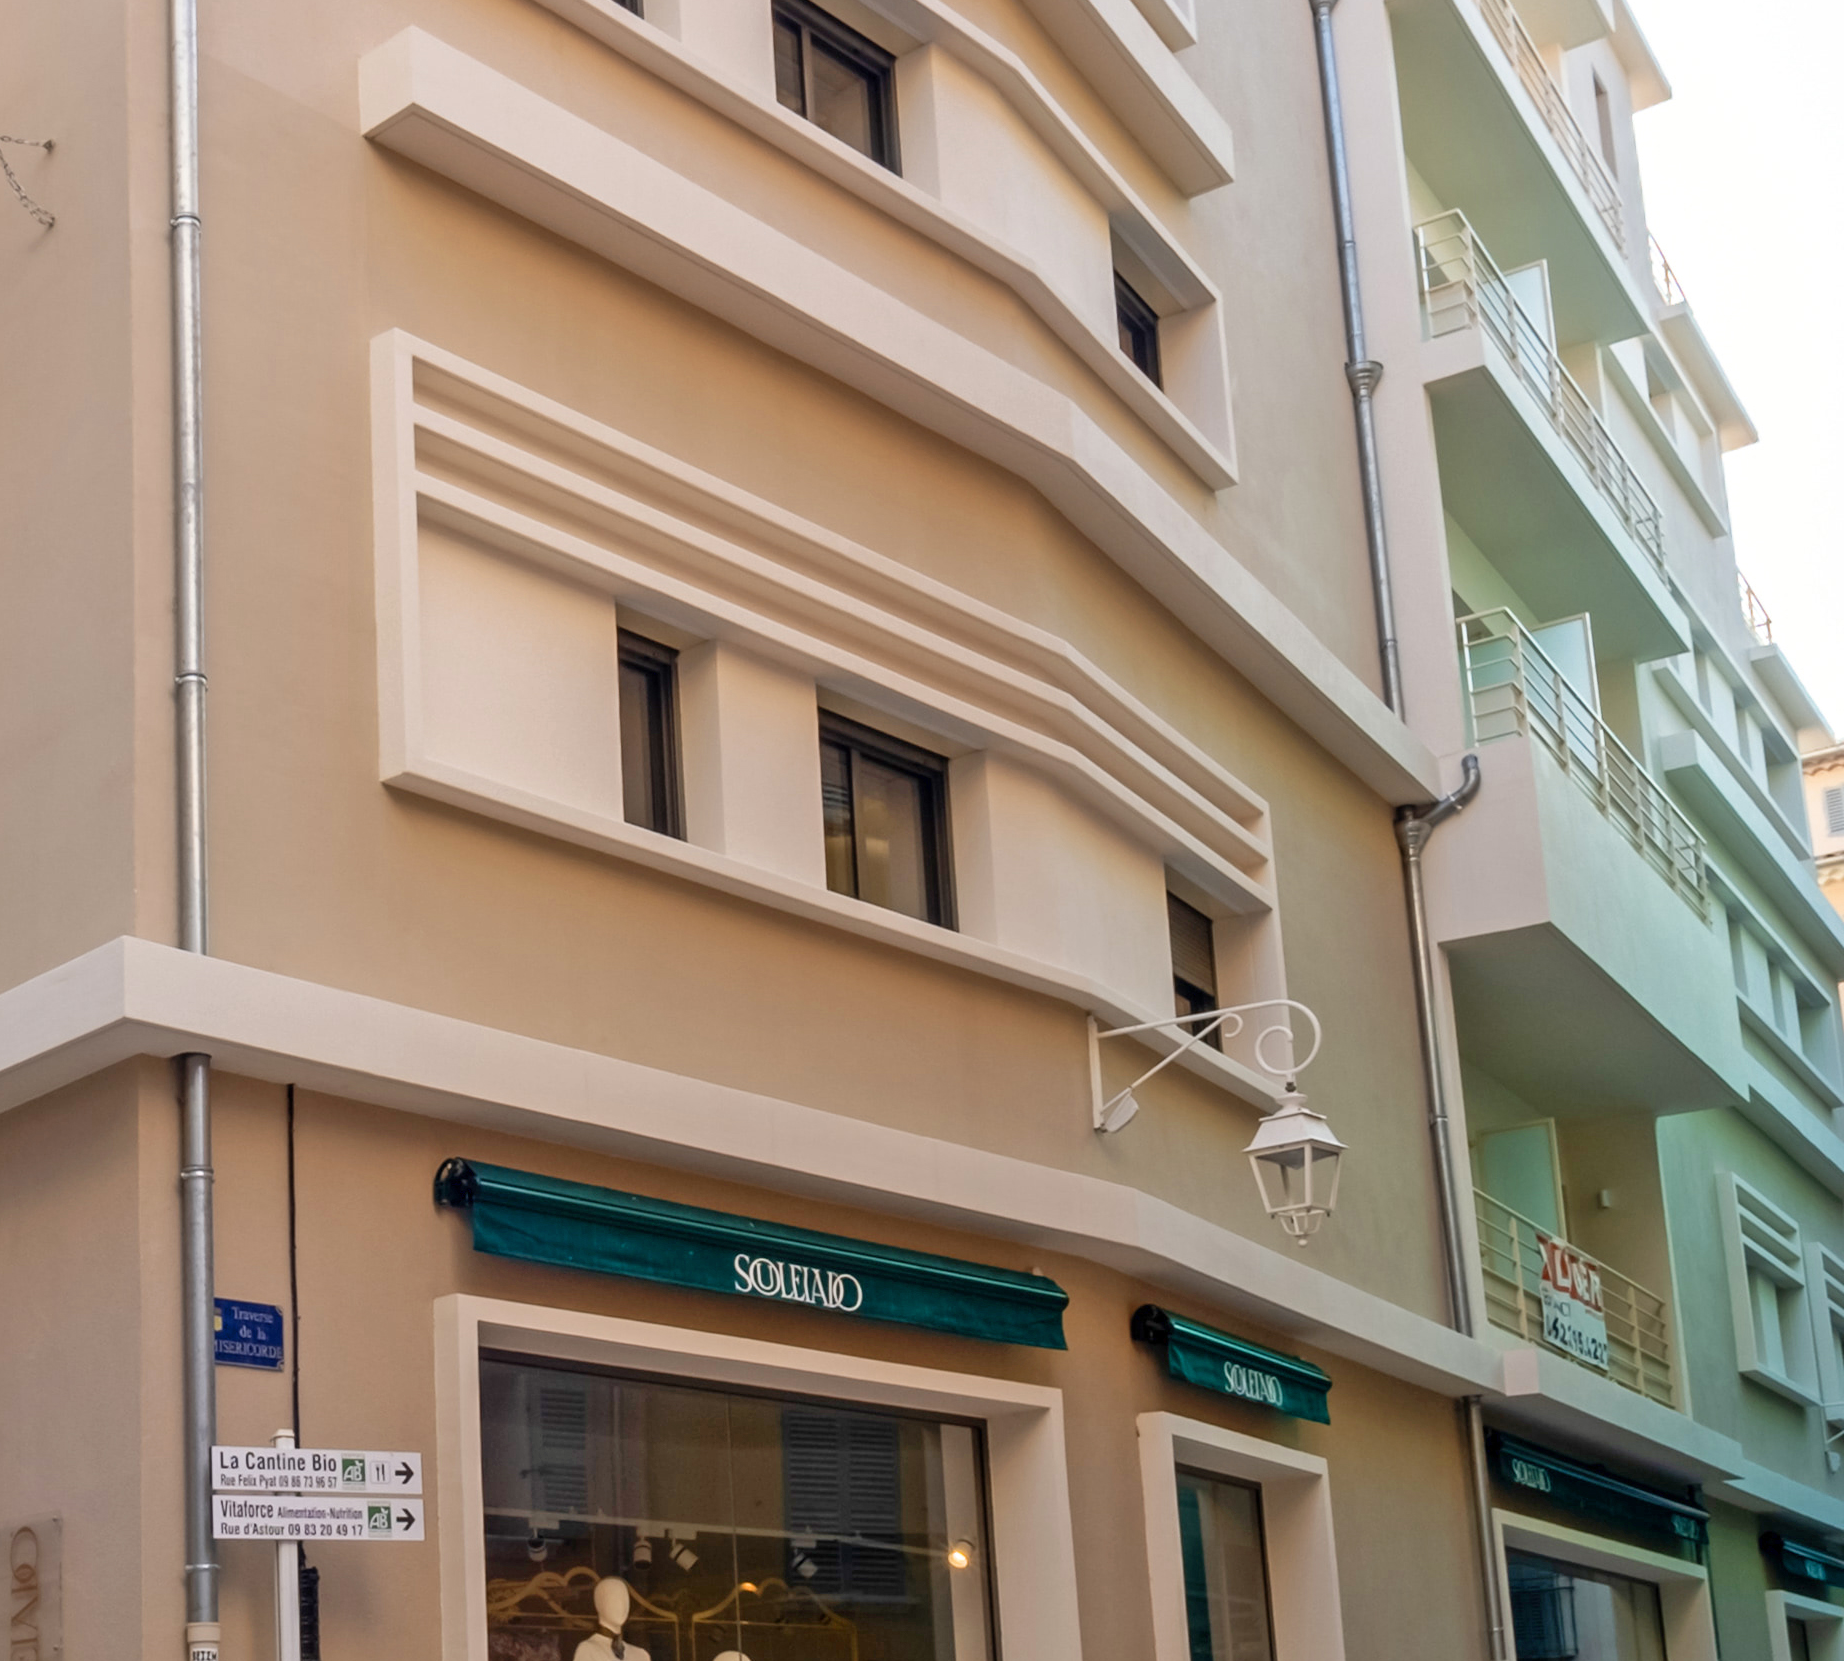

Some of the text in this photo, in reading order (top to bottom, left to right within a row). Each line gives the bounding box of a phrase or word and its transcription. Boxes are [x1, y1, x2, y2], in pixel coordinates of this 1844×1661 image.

[231, 1306, 274, 1324] Traverse
[239, 1324, 267, 1341] de la
[220, 1451, 337, 1472] La Cantine Bio
[220, 1473, 236, 1487] Rue
[259, 1474, 277, 1489] Pyat
[279, 1475, 289, 1488] 09
[303, 1476, 313, 1488] 73
[328, 1476, 337, 1489] 57
[343, 1463, 363, 1481] AB
[220, 1499, 274, 1518] Vitaforce
[369, 1511, 389, 1529] AB
[221, 1523, 364, 1536] Rue d'Astour 09 83 20 49 17
